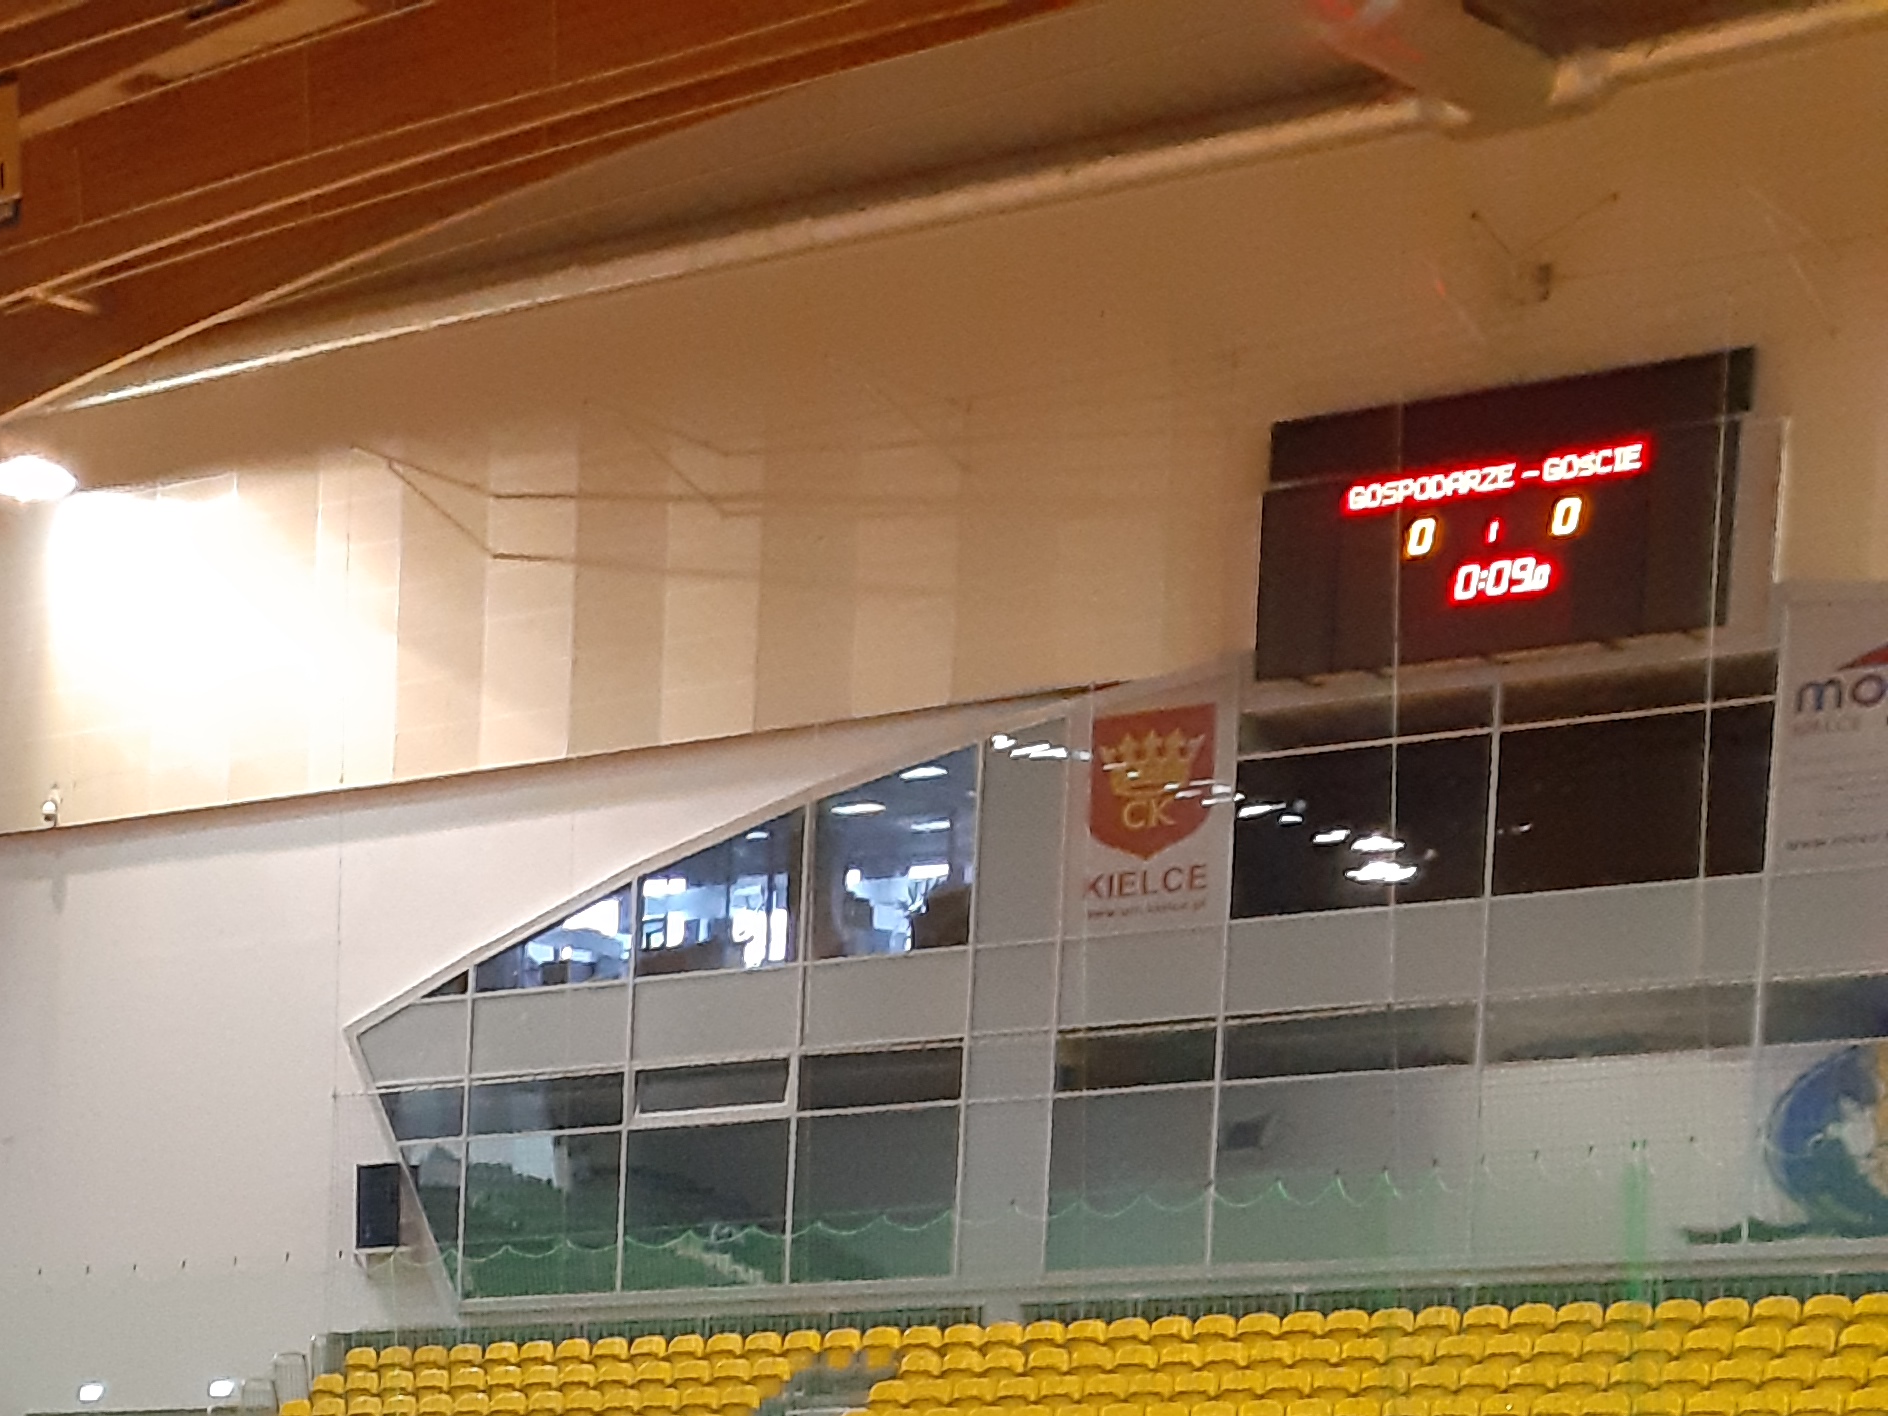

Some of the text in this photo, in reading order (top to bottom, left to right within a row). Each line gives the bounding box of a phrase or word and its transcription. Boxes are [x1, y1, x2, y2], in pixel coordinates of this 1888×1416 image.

[1347, 462, 1517, 511] GOSPODARZE
[1406, 517, 1437, 557] 0
[1551, 496, 1583, 537] 0
[1124, 800, 1176, 830] CK
[1086, 863, 1208, 899] KIELCE
